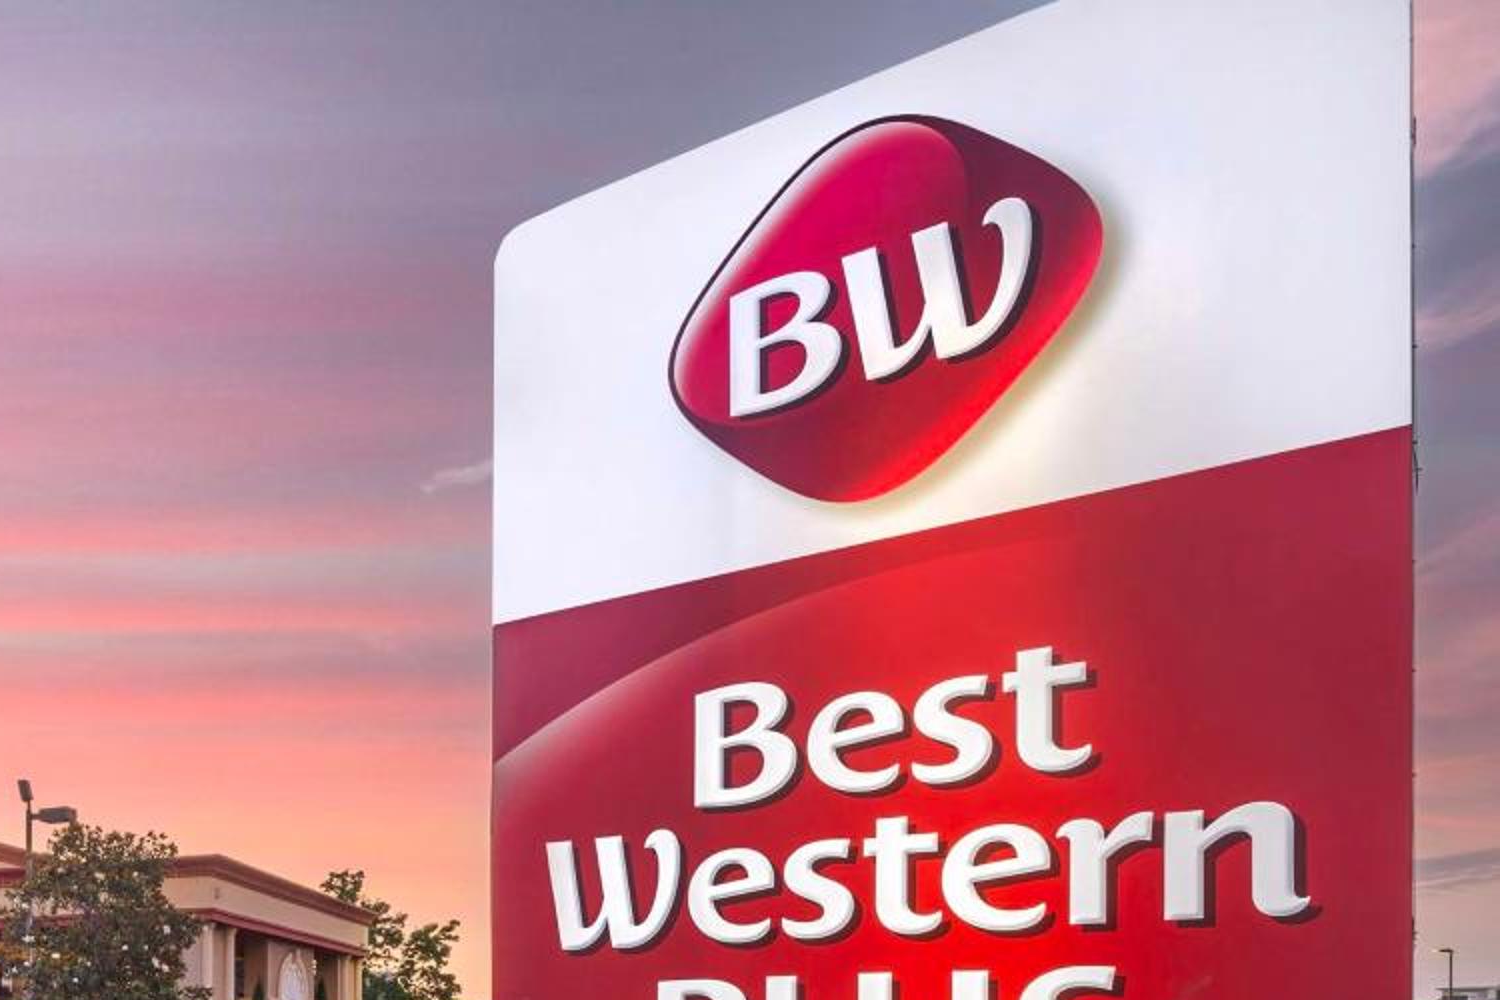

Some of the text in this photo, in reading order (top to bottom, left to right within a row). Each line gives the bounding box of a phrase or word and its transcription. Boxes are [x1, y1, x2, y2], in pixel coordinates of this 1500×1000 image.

[728, 197, 1032, 418] BW
[692, 645, 1093, 809] Best
[545, 801, 1311, 951] Western
